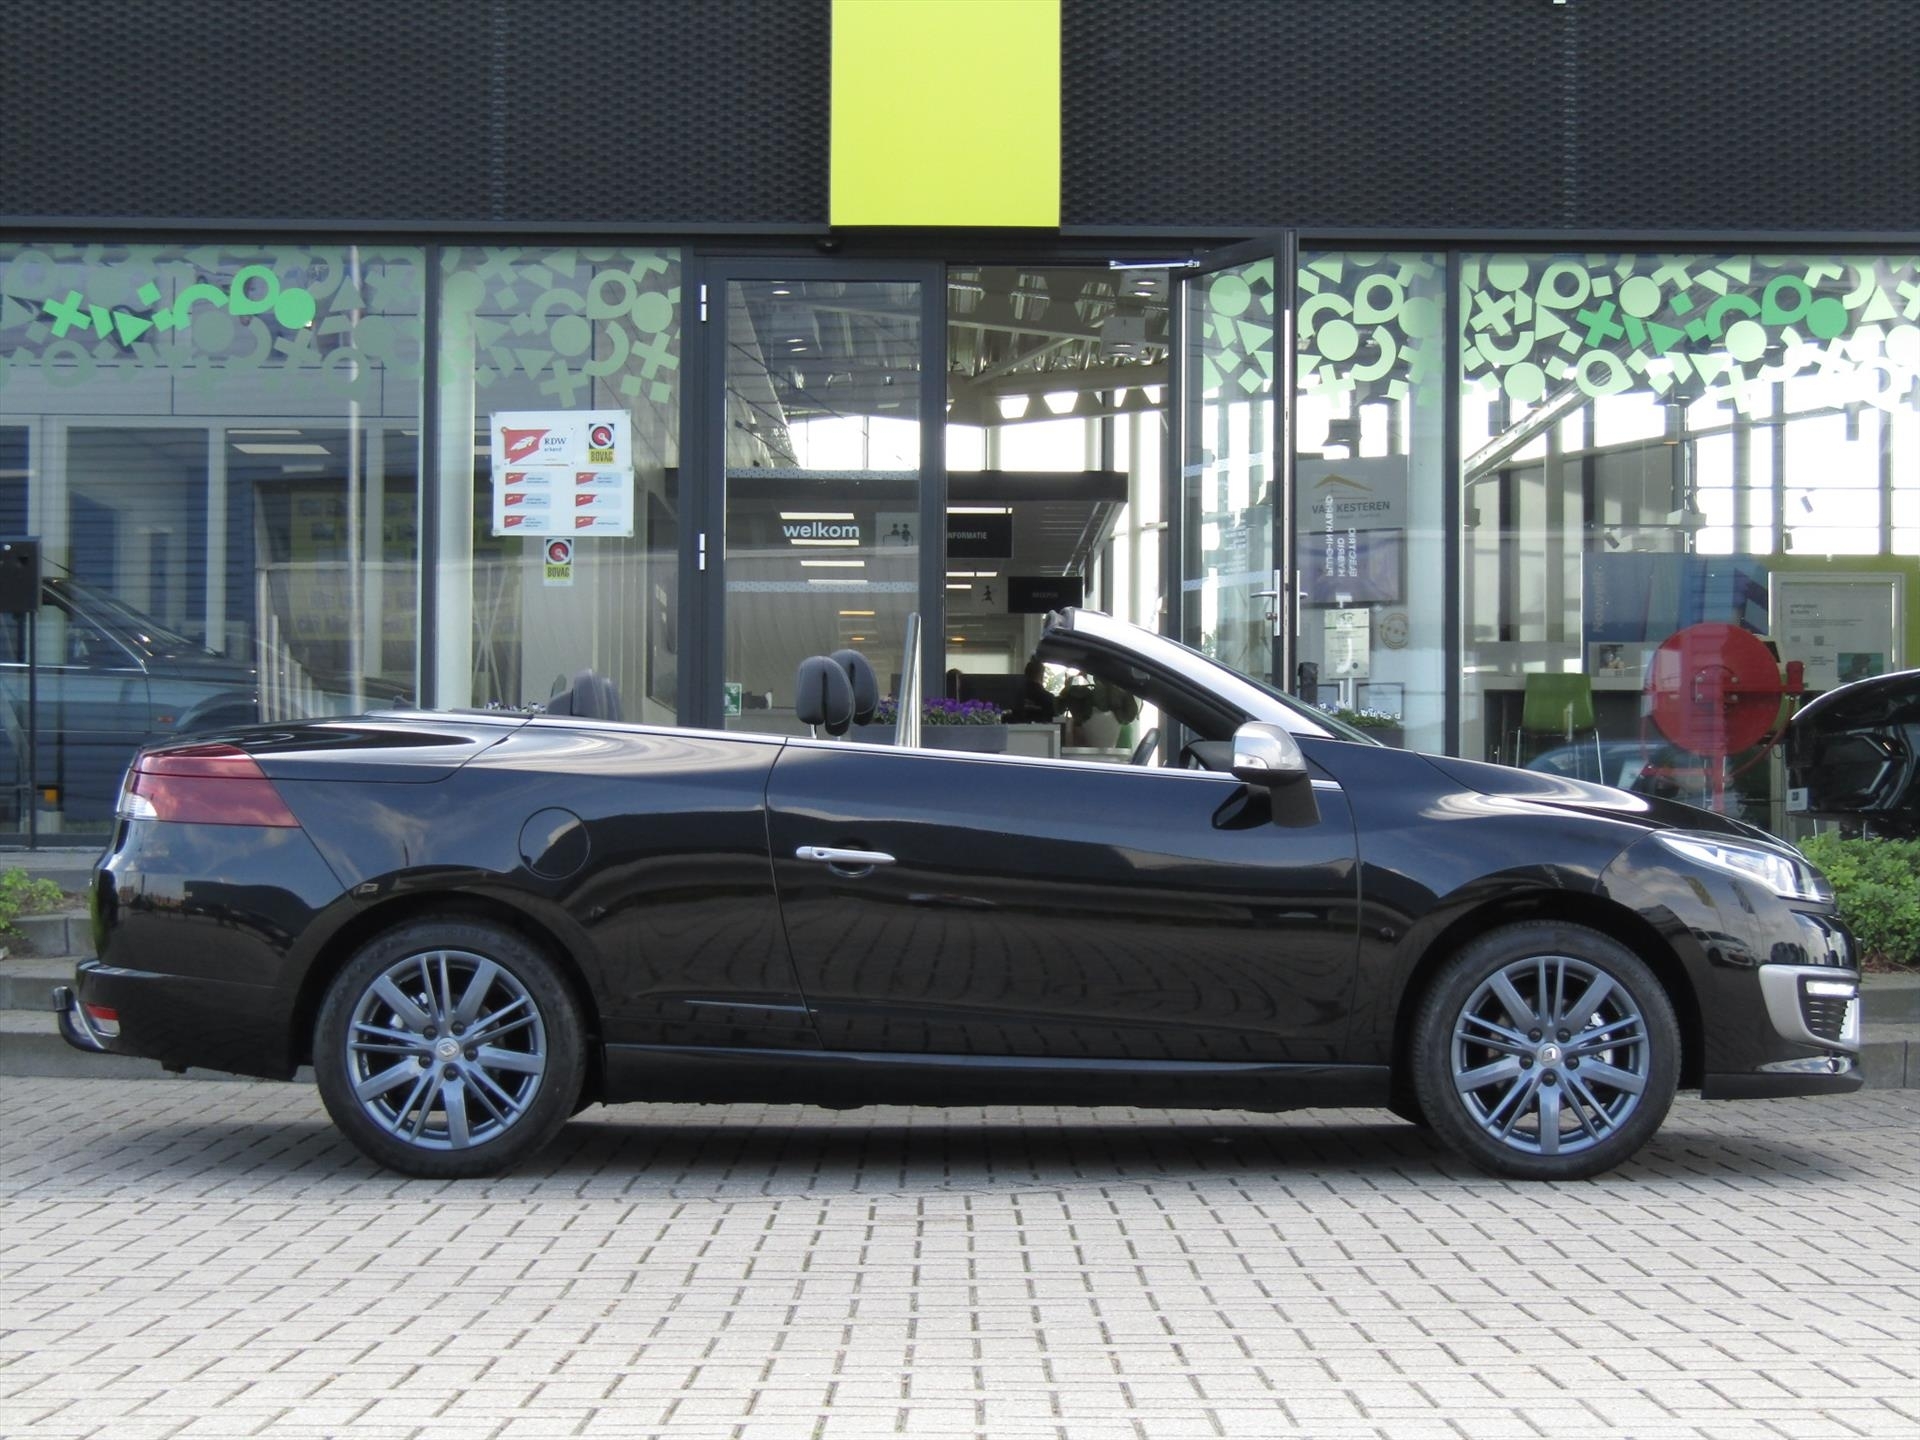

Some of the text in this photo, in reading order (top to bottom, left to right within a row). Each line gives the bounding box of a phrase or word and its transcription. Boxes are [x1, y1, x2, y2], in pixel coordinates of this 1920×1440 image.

[544, 437, 567, 445] RDW
[590, 451, 613, 462] BOVAG
[1312, 501, 1390, 514] VA KESTEREN
[783, 522, 860, 537] welkom
[947, 531, 988, 539] NFORMATIE
[547, 567, 570, 577] BOVAG
